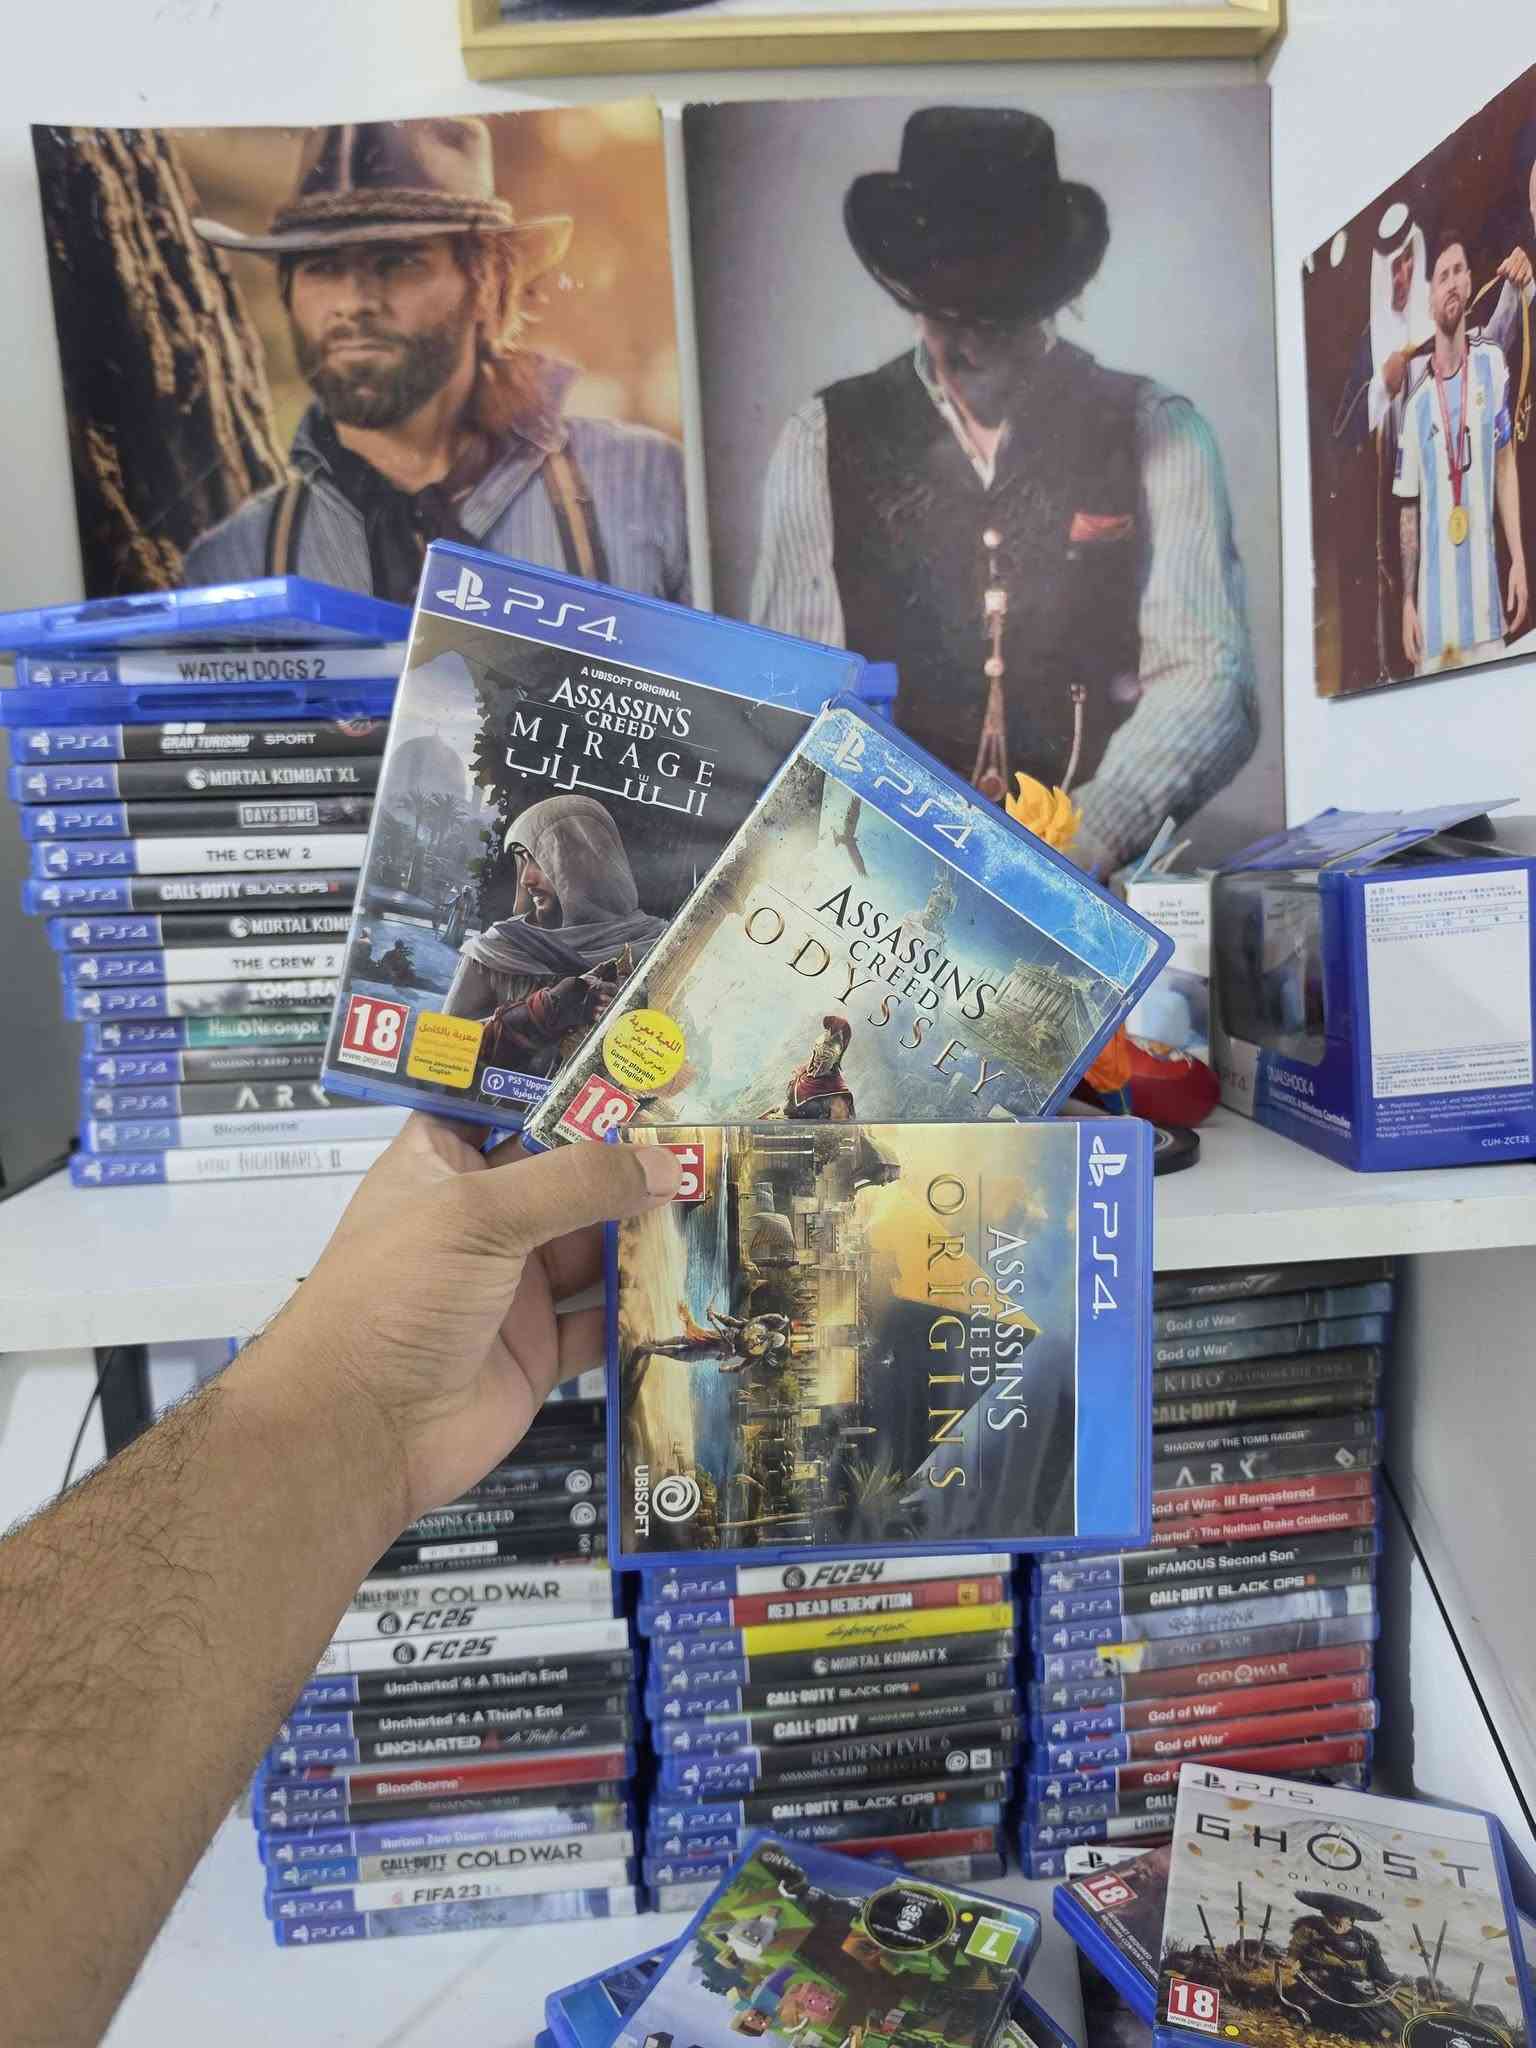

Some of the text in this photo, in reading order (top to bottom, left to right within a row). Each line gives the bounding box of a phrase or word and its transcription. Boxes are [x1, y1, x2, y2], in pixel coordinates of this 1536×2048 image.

[503, 588, 618, 643] PS4
[178, 659, 326, 681] WATCH DOGS 2
[581, 666, 681, 700] A UBISOFT ORIGINAL
[549, 678, 692, 737] ASSASSIN'S
[584, 710, 656, 740] CREED
[56, 735, 112, 749] PS4
[264, 733, 317, 745] SPORT
[512, 712, 715, 787] MIRAGE
[53, 776, 106, 790] PS4
[210, 768, 360, 785] MORTAL KOMBAT XL
[873, 767, 974, 849] PS4
[75, 852, 128, 866] PS4
[206, 847, 312, 862] THE CREW 2
[65, 889, 118, 902] PS4
[161, 884, 198, 900] CALL
[202, 883, 241, 898] DUTY
[98, 925, 149, 939] PS4
[252, 918, 309, 934] MORTAL
[233, 956, 335, 970] THE CREW 2
[847, 941, 940, 1011] CREED
[744, 906, 1007, 1097] ODYSSEY
[352, 1003, 401, 1052] 18
[526, 1079, 551, 1092] Upgra
[574, 1087, 628, 1138] 18
[213, 1121, 299, 1136] Bloodborne
[1091, 1201, 1120, 1319] PS4
[927, 1173, 967, 1489] ORIGINS
[969, 1277, 993, 1386] CREED
[986, 1225, 1029, 1432] ASSASSIN'S
[1166, 1314, 1238, 1332] God of War
[1157, 1345, 1228, 1362] God of War
[1192, 1400, 1237, 1421] DUTY
[1164, 1430, 1305, 1453] SHADOW OF THE TOMB RAIDER
[634, 1464, 650, 1537] UBISOFT
[1176, 1487, 1315, 1512] of War III Remastered
[1201, 1511, 1349, 1538] The Nathan Drake Collection
[1147, 1550, 1295, 1577] inFAMOUS Second Son
[431, 1581, 560, 1605] COLD WAR
[1150, 1576, 1305, 1606] CALL DUTY BLACK OPS
[830, 1654, 883, 1672] MORTAL
[384, 1677, 459, 1697] Uncharted
[477, 1674, 490, 1688] A
[539, 1668, 568, 1682] End
[766, 1691, 797, 1706] CALL
[802, 1688, 835, 1704] DUTY
[378, 1712, 453, 1732] Uncharted
[472, 1710, 485, 1723] A
[534, 1704, 564, 1718] End
[1148, 1704, 1218, 1722] God of War
[773, 1715, 860, 1740] CALL DUTY
[374, 1735, 481, 1757] UNCHARTED
[1154, 1734, 1224, 1753] God of War
[376, 1778, 460, 1795] Bloodborne
[1143, 1771, 1169, 1785] God
[772, 1791, 936, 1820] CALL DUTY BLACK OPS
[1235, 1783, 1315, 1805] PS5
[380, 1841, 584, 1872] CALL DUTY COLD WAR
[1196, 1813, 1480, 1889] GHOST
[413, 1883, 482, 1904] FIFA 23
[1089, 1874, 1129, 1904] 18
[979, 1930, 1002, 1957] 7
[1175, 1984, 1214, 2019] 18
